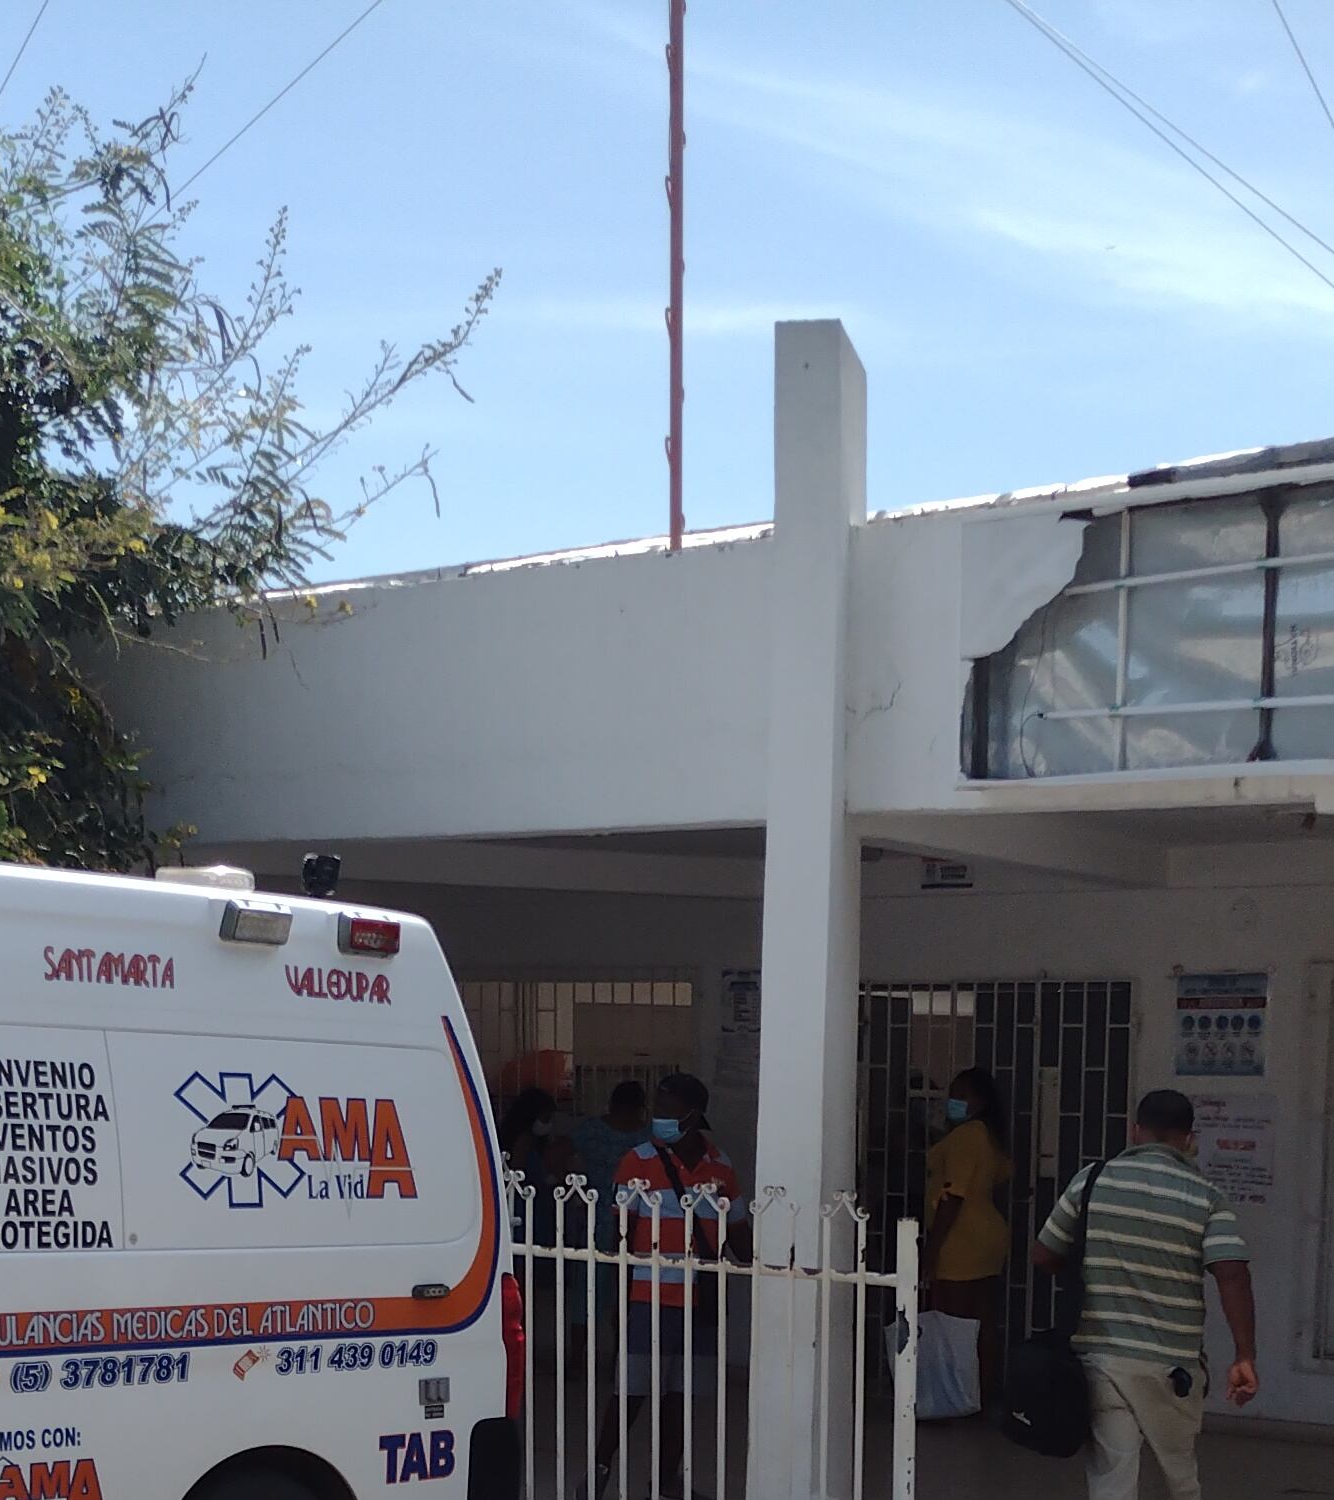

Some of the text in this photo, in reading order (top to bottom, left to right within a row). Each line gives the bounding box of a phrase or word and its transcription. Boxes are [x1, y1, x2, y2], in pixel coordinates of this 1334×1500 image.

[284, 963, 392, 1005] VALLEDUPAR
[276, 1096, 419, 1199] AMA
[4, 1189, 75, 1217] AREA
[307, 1174, 331, 1200] La
[111, 1308, 208, 1342] MEDICAS
[214, 1306, 252, 1337] DEL
[259, 1300, 375, 1334] ATLANTICO
[10, 1339, 437, 1393] (5) 3781781 311 439 0149
[41, 1427, 81, 1449] CON:
[379, 1430, 455, 1484] TAB
